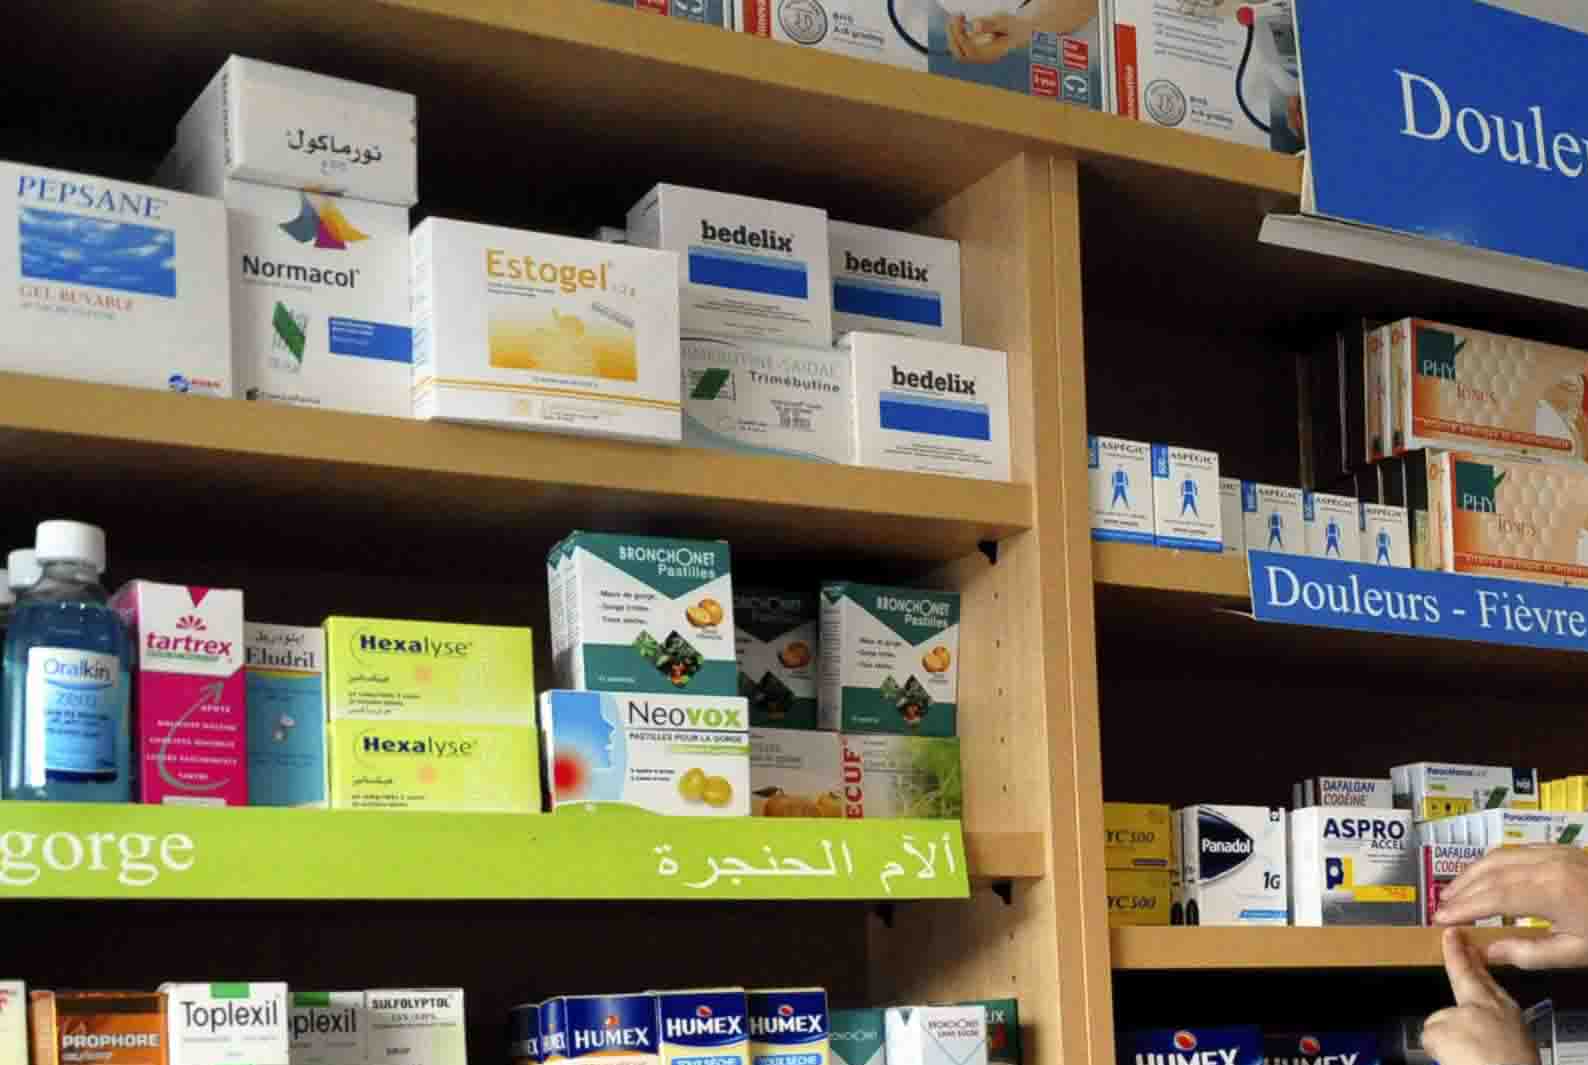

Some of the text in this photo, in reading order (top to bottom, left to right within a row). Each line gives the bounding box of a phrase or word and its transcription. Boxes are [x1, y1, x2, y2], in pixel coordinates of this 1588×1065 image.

[17, 174, 163, 221] PEPSANE
[700, 219, 793, 253] bedelix
[242, 253, 356, 289] Normacol
[484, 248, 610, 297] Estogel
[844, 251, 930, 283] bedelix
[890, 364, 977, 396] bedelix
[618, 545, 716, 568] BRONCHONET
[657, 563, 716, 580] Pastilles
[1264, 565, 1441, 625] Douleurs
[1479, 588, 1588, 639] Fièvre
[146, 632, 233, 657] tartrex
[360, 633, 469, 658] Hexalyse
[42, 658, 111, 682] Oralkin
[628, 700, 744, 729] Neovox
[363, 736, 473, 759] Hexalyse
[629, 733, 674, 744] PASTILLES
[675, 734, 700, 744] POUR
[1322, 779, 1376, 794] DAFALGAN
[1322, 818, 1405, 840] ASPRO
[1201, 837, 1252, 855] Panadol
[1370, 839, 1406, 851] ACCEL
[0, 828, 195, 887] gorge
[655, 840, 856, 889] الحنجرة
[1130, 895, 1157, 910] 500
[371, 997, 450, 1010] SULFOLYPTOL
[181, 1000, 279, 1033] Toplexil
[666, 1015, 743, 1038] HUMEX
[750, 1013, 824, 1035] HUMEX
[61, 1033, 161, 1049] PROPHORE
[574, 1027, 649, 1050] HUMEX
